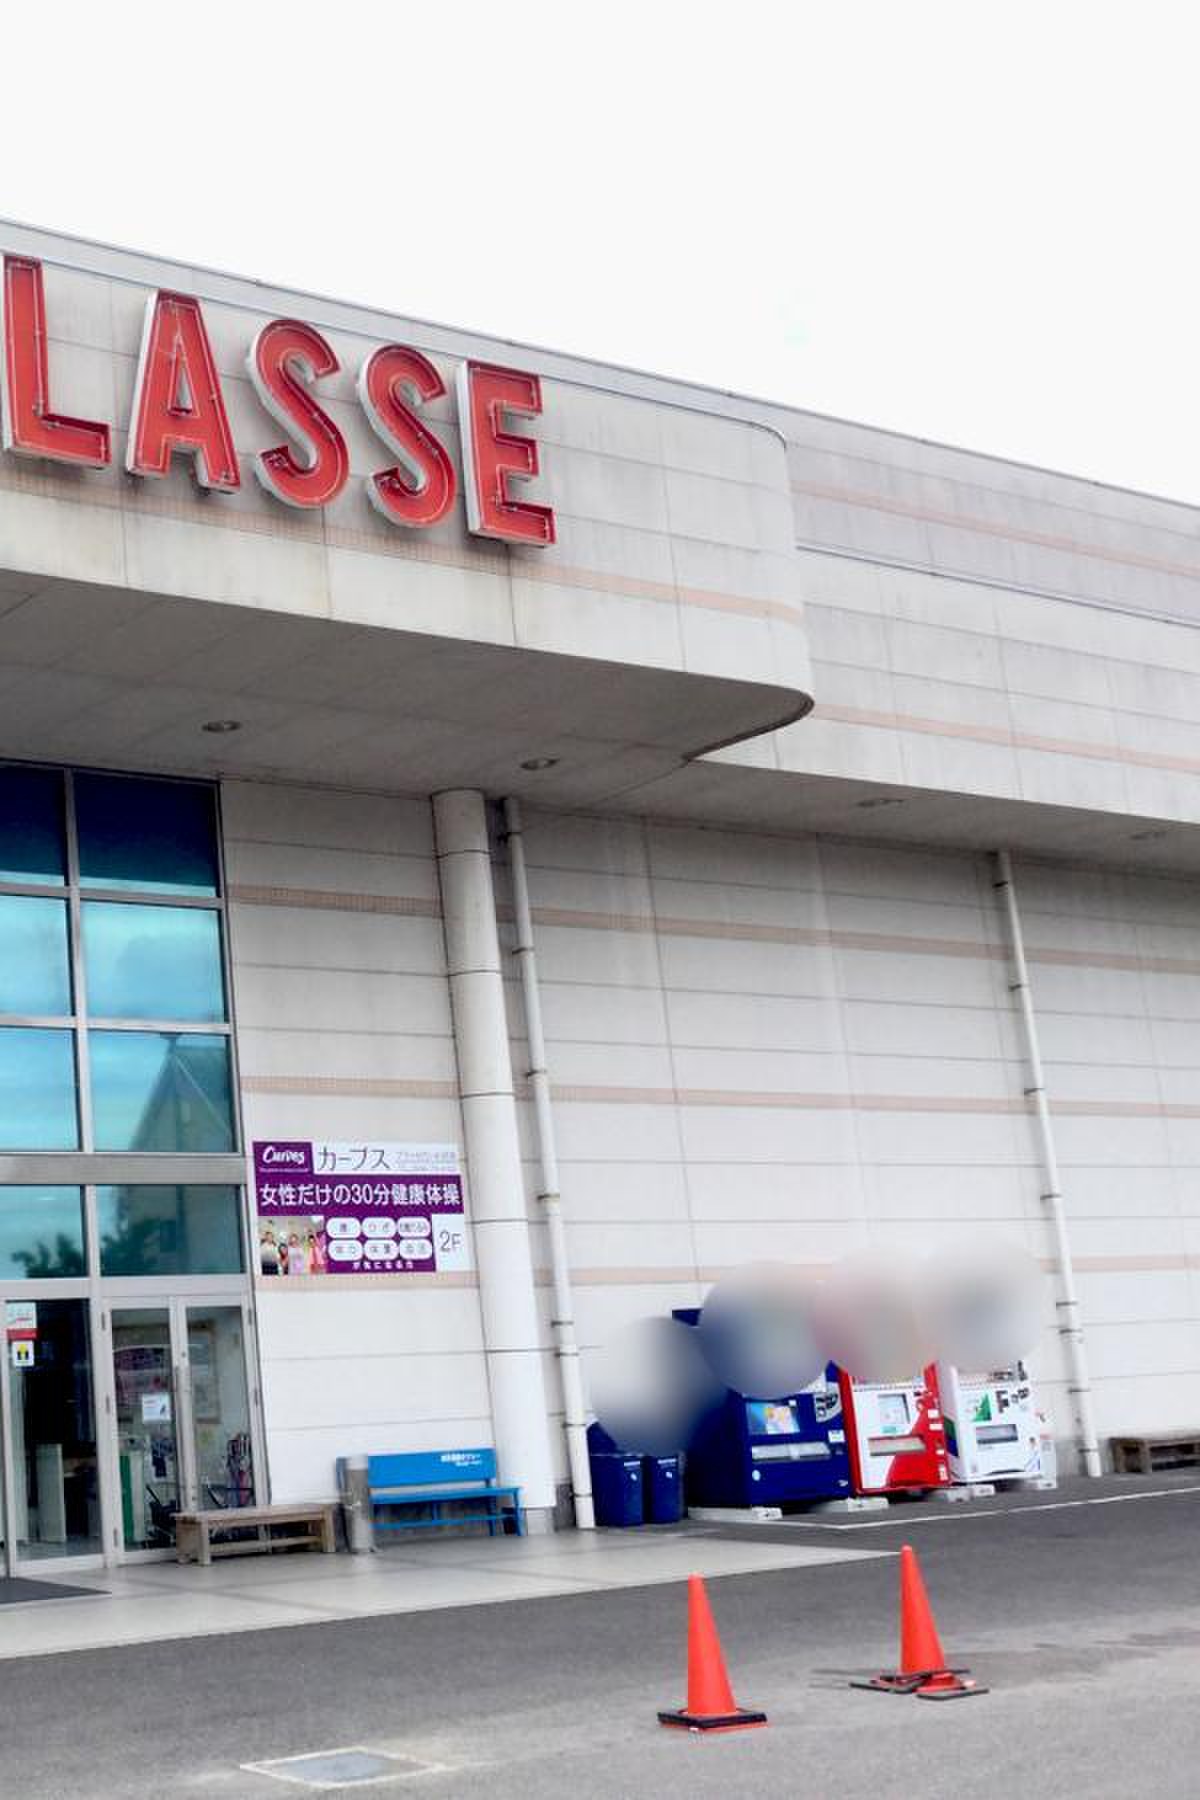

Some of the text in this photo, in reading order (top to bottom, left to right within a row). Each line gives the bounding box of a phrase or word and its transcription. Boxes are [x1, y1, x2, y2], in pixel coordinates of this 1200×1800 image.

[262, 1145, 305, 1165] Curves
[316, 1146, 390, 1171] カーブス
[259, 1183, 461, 1206] 女性だけの30分健康体操
[439, 1230, 462, 1253] 2F
